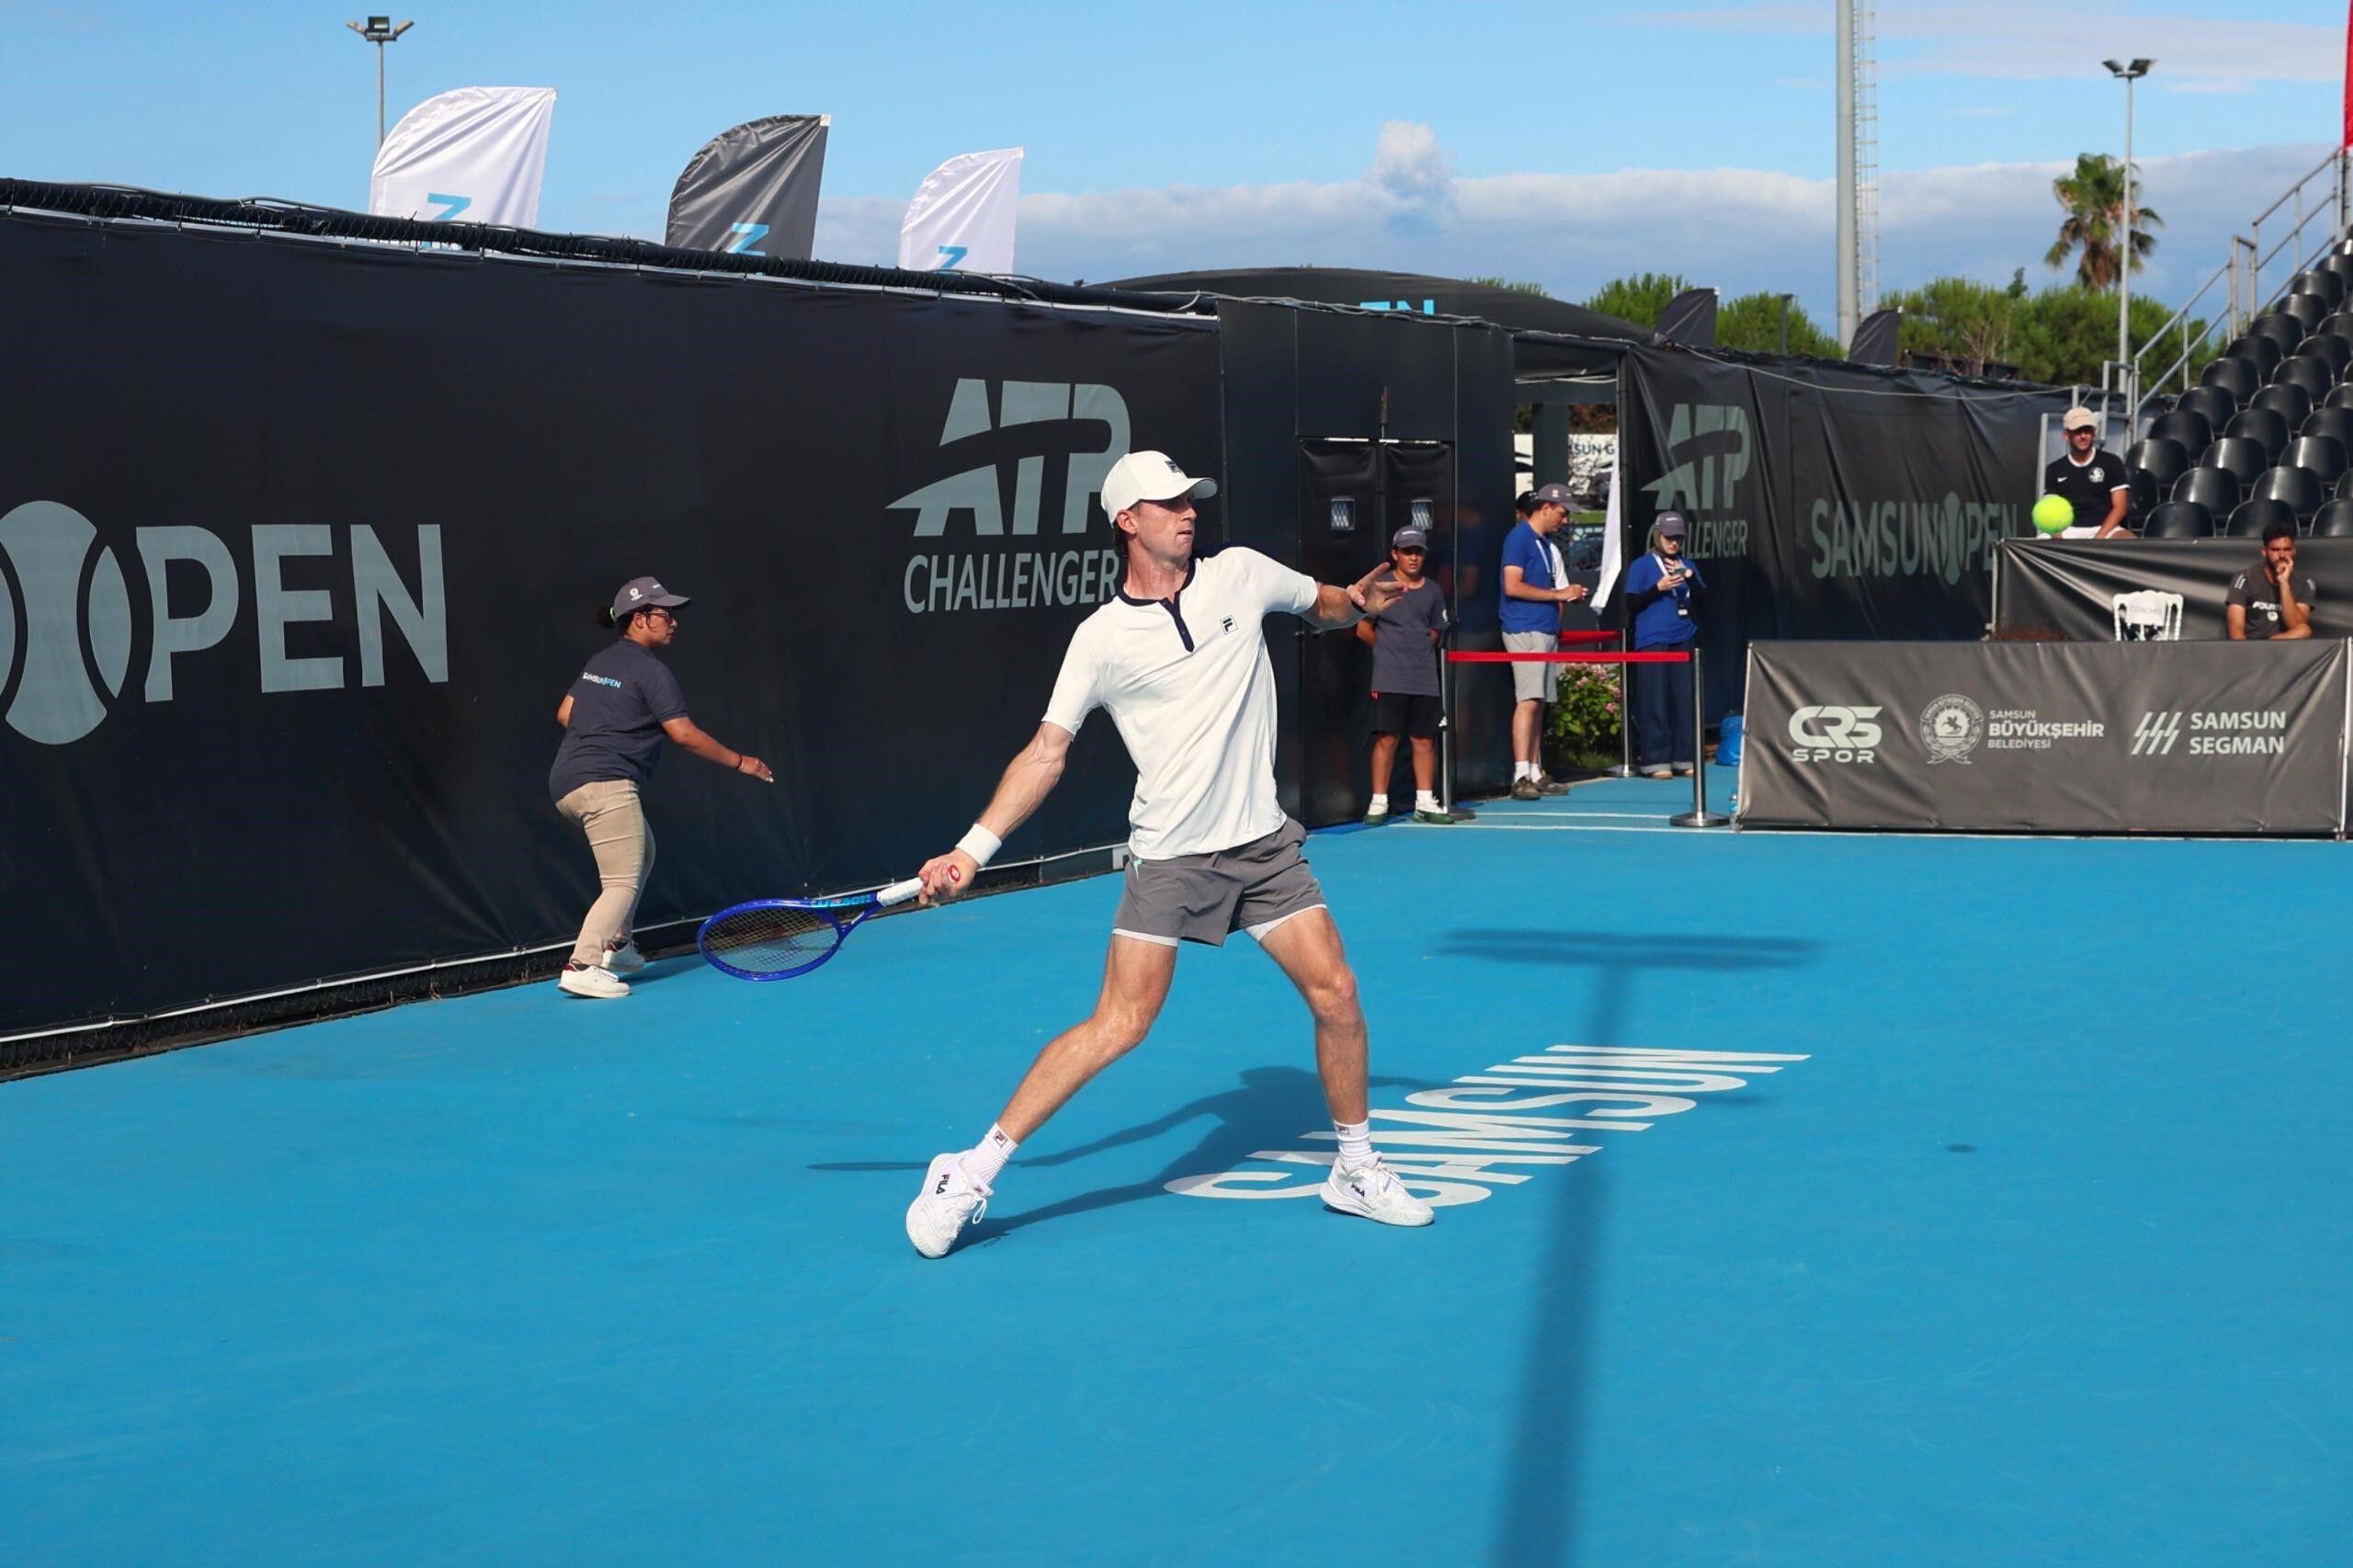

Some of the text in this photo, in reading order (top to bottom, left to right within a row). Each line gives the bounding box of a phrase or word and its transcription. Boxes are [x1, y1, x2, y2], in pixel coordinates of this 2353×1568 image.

[885, 378, 1131, 536] ATP
[1641, 403, 1750, 510] ATP
[1646, 519, 1748, 559] CLLENGER
[904, 550, 1122, 614] CHALLENGER
[1989, 710, 2036, 720] SAMSUN
[2190, 711, 2286, 730] SAMSUN
[1989, 720, 2105, 739] BÜYÜKŞEHİR
[1987, 739, 2051, 749] BELEDİYESİ
[2188, 736, 2284, 755] SEGMAN
[1792, 749, 1875, 763] SPOR
[1165, 1044, 1812, 1208] SAMSUN
[936, 1174, 950, 1195] FILA
